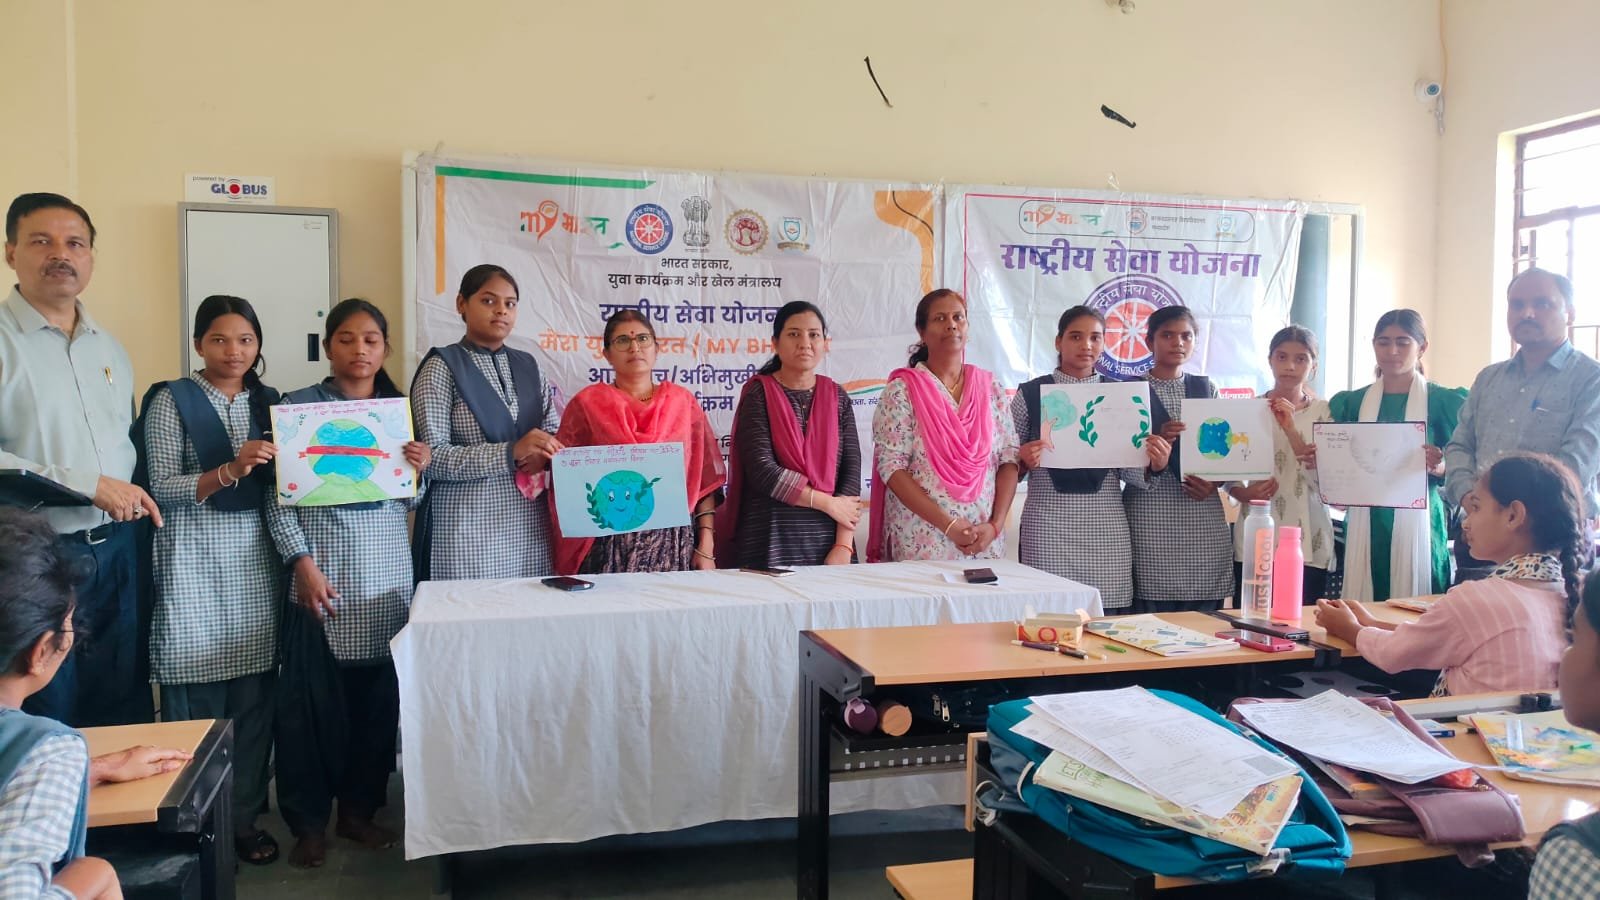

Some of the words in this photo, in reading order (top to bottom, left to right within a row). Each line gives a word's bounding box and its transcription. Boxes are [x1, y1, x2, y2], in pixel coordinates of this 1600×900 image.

[211, 183, 267, 196] GLOBUS
[661, 258, 689, 269] भारत
[692, 258, 733, 271] सरकार,
[1000, 238, 1096, 275] राष्ट्रीय
[1103, 240, 1161, 275] सेवा
[1168, 242, 1262, 277] योजना
[608, 273, 632, 288] युवा
[634, 272, 684, 287] कार्यक्रम
[687, 272, 708, 287] और
[711, 273, 735, 288] खेल
[737, 274, 782, 288] मंत्रालय
[675, 300, 716, 324] सेवा
[707, 338, 740, 354] MY
[1115, 362, 1149, 375] SERVICE
